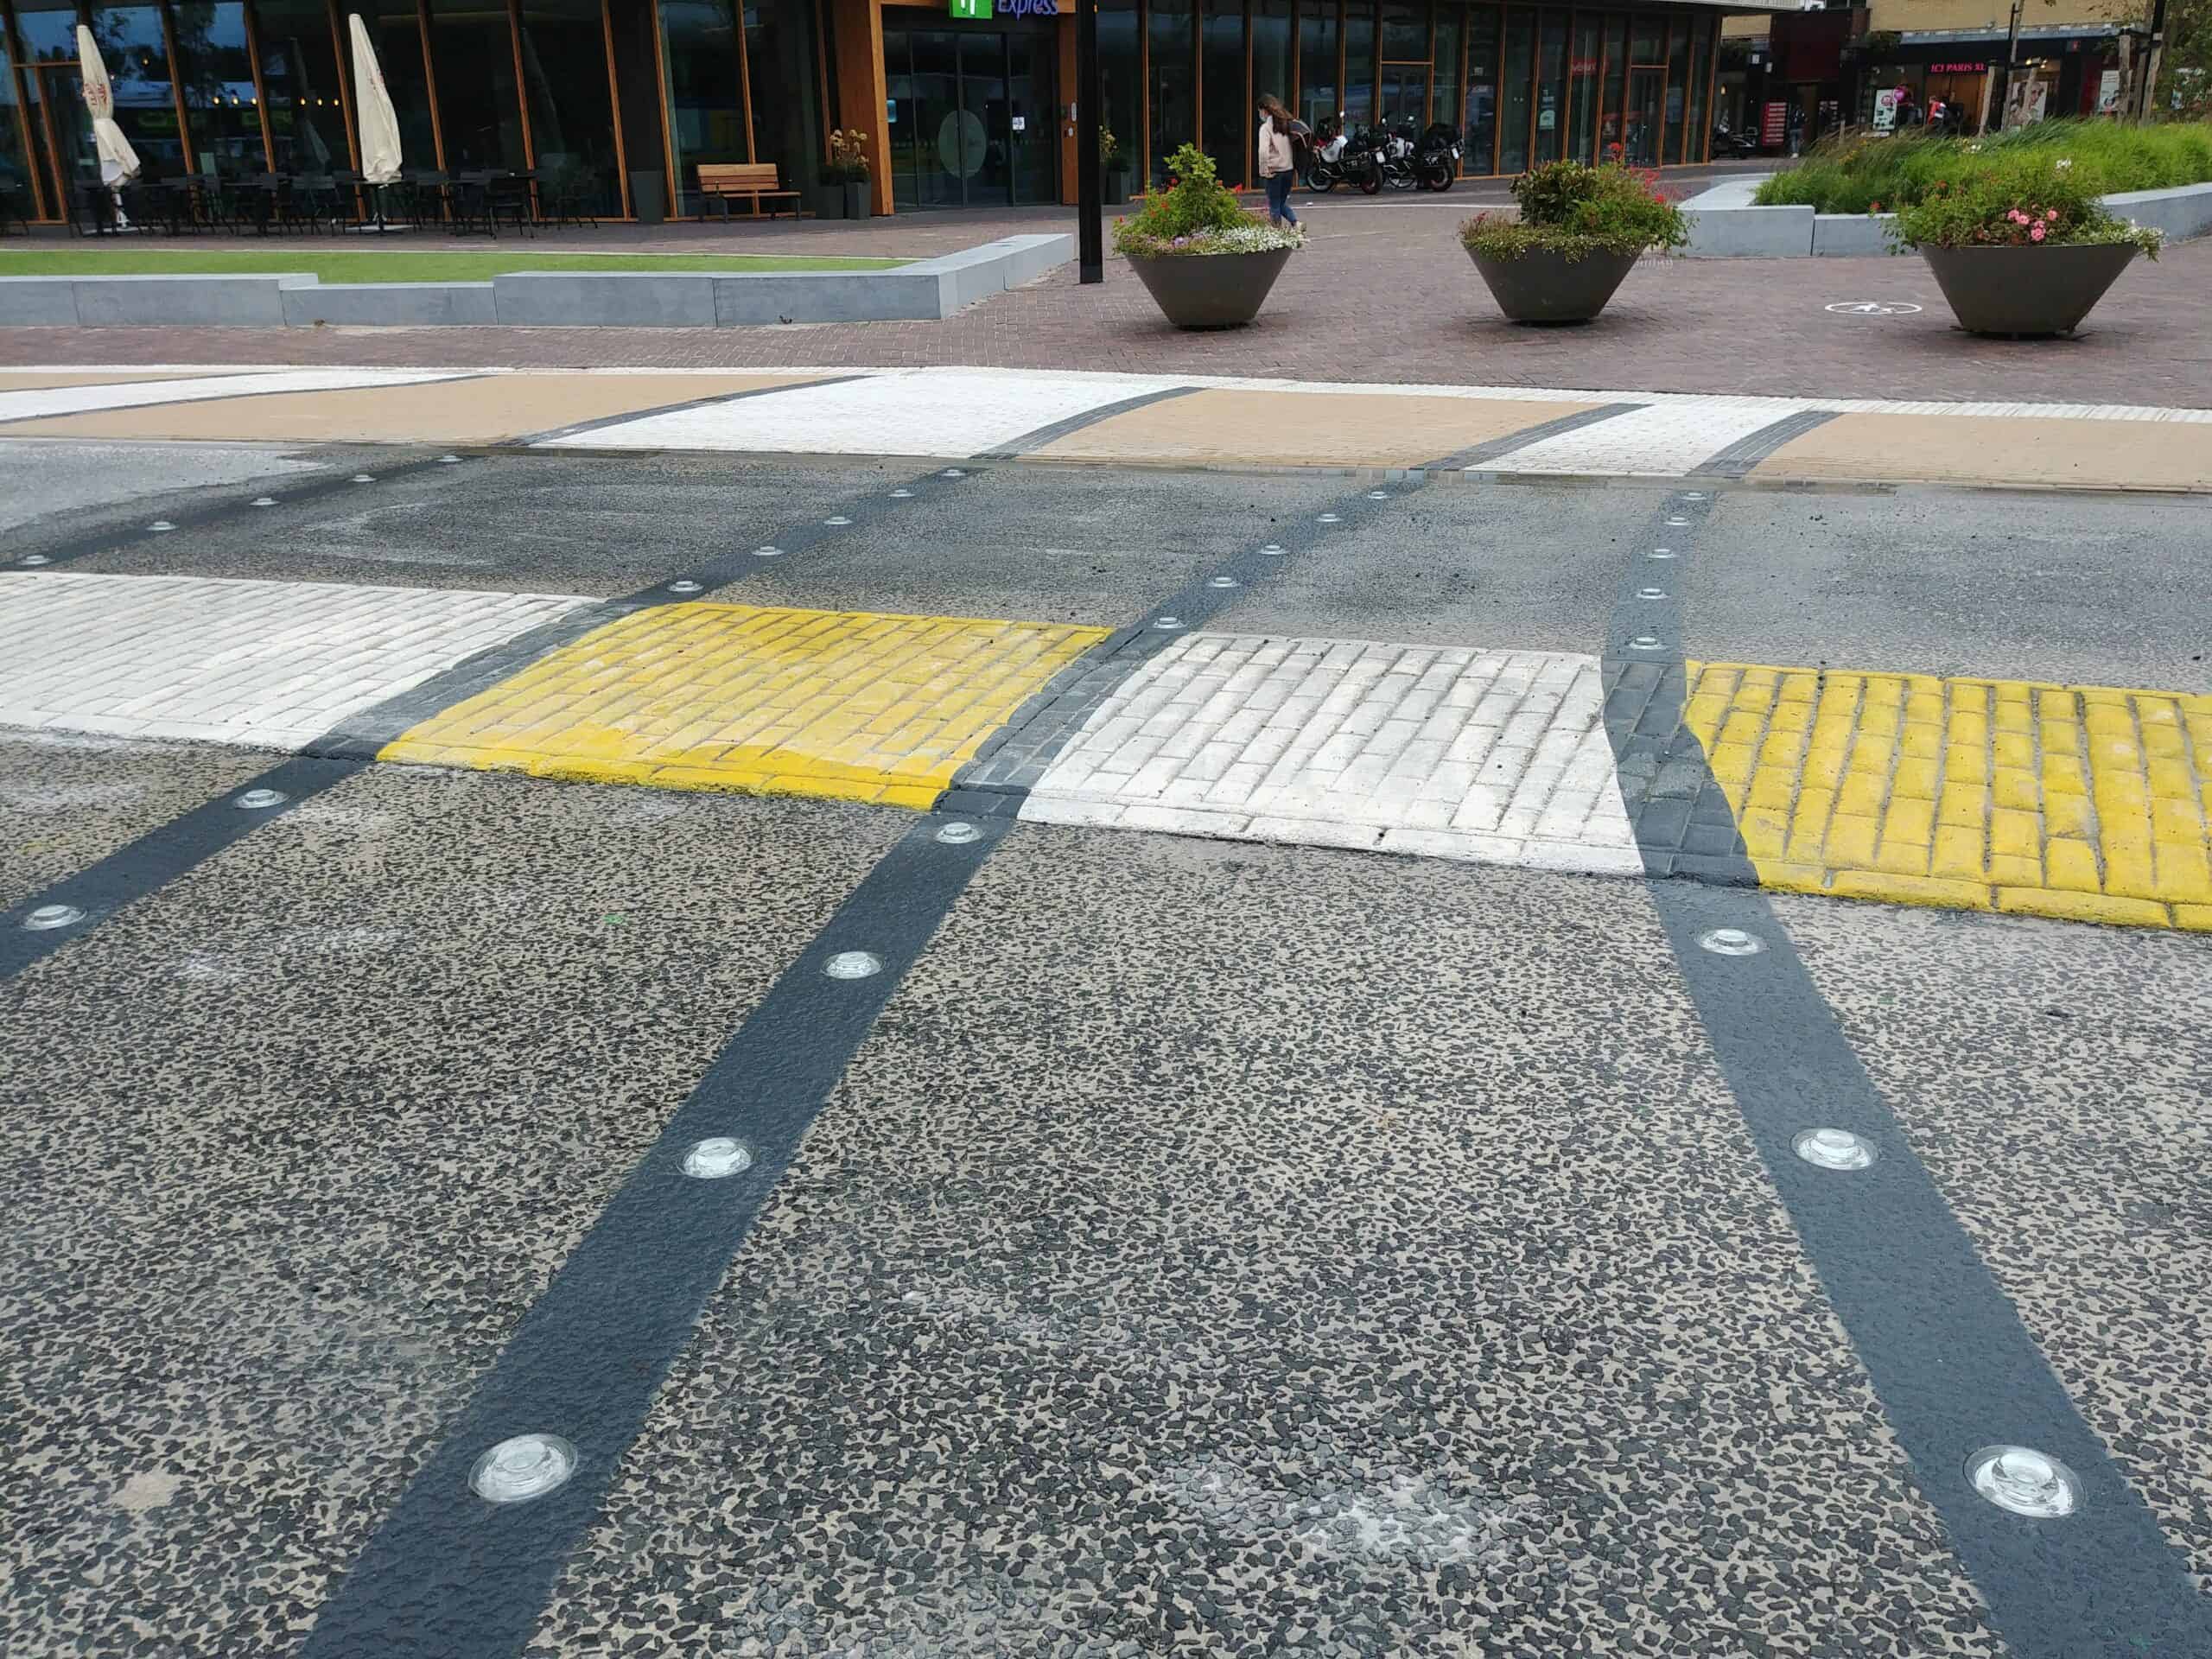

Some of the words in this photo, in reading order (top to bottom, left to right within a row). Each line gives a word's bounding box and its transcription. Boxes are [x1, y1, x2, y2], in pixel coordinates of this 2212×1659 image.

[997, 0, 1058, 20] Express
[1931, 64, 1944, 73] ICI
[1946, 63, 1972, 72] PARIS
